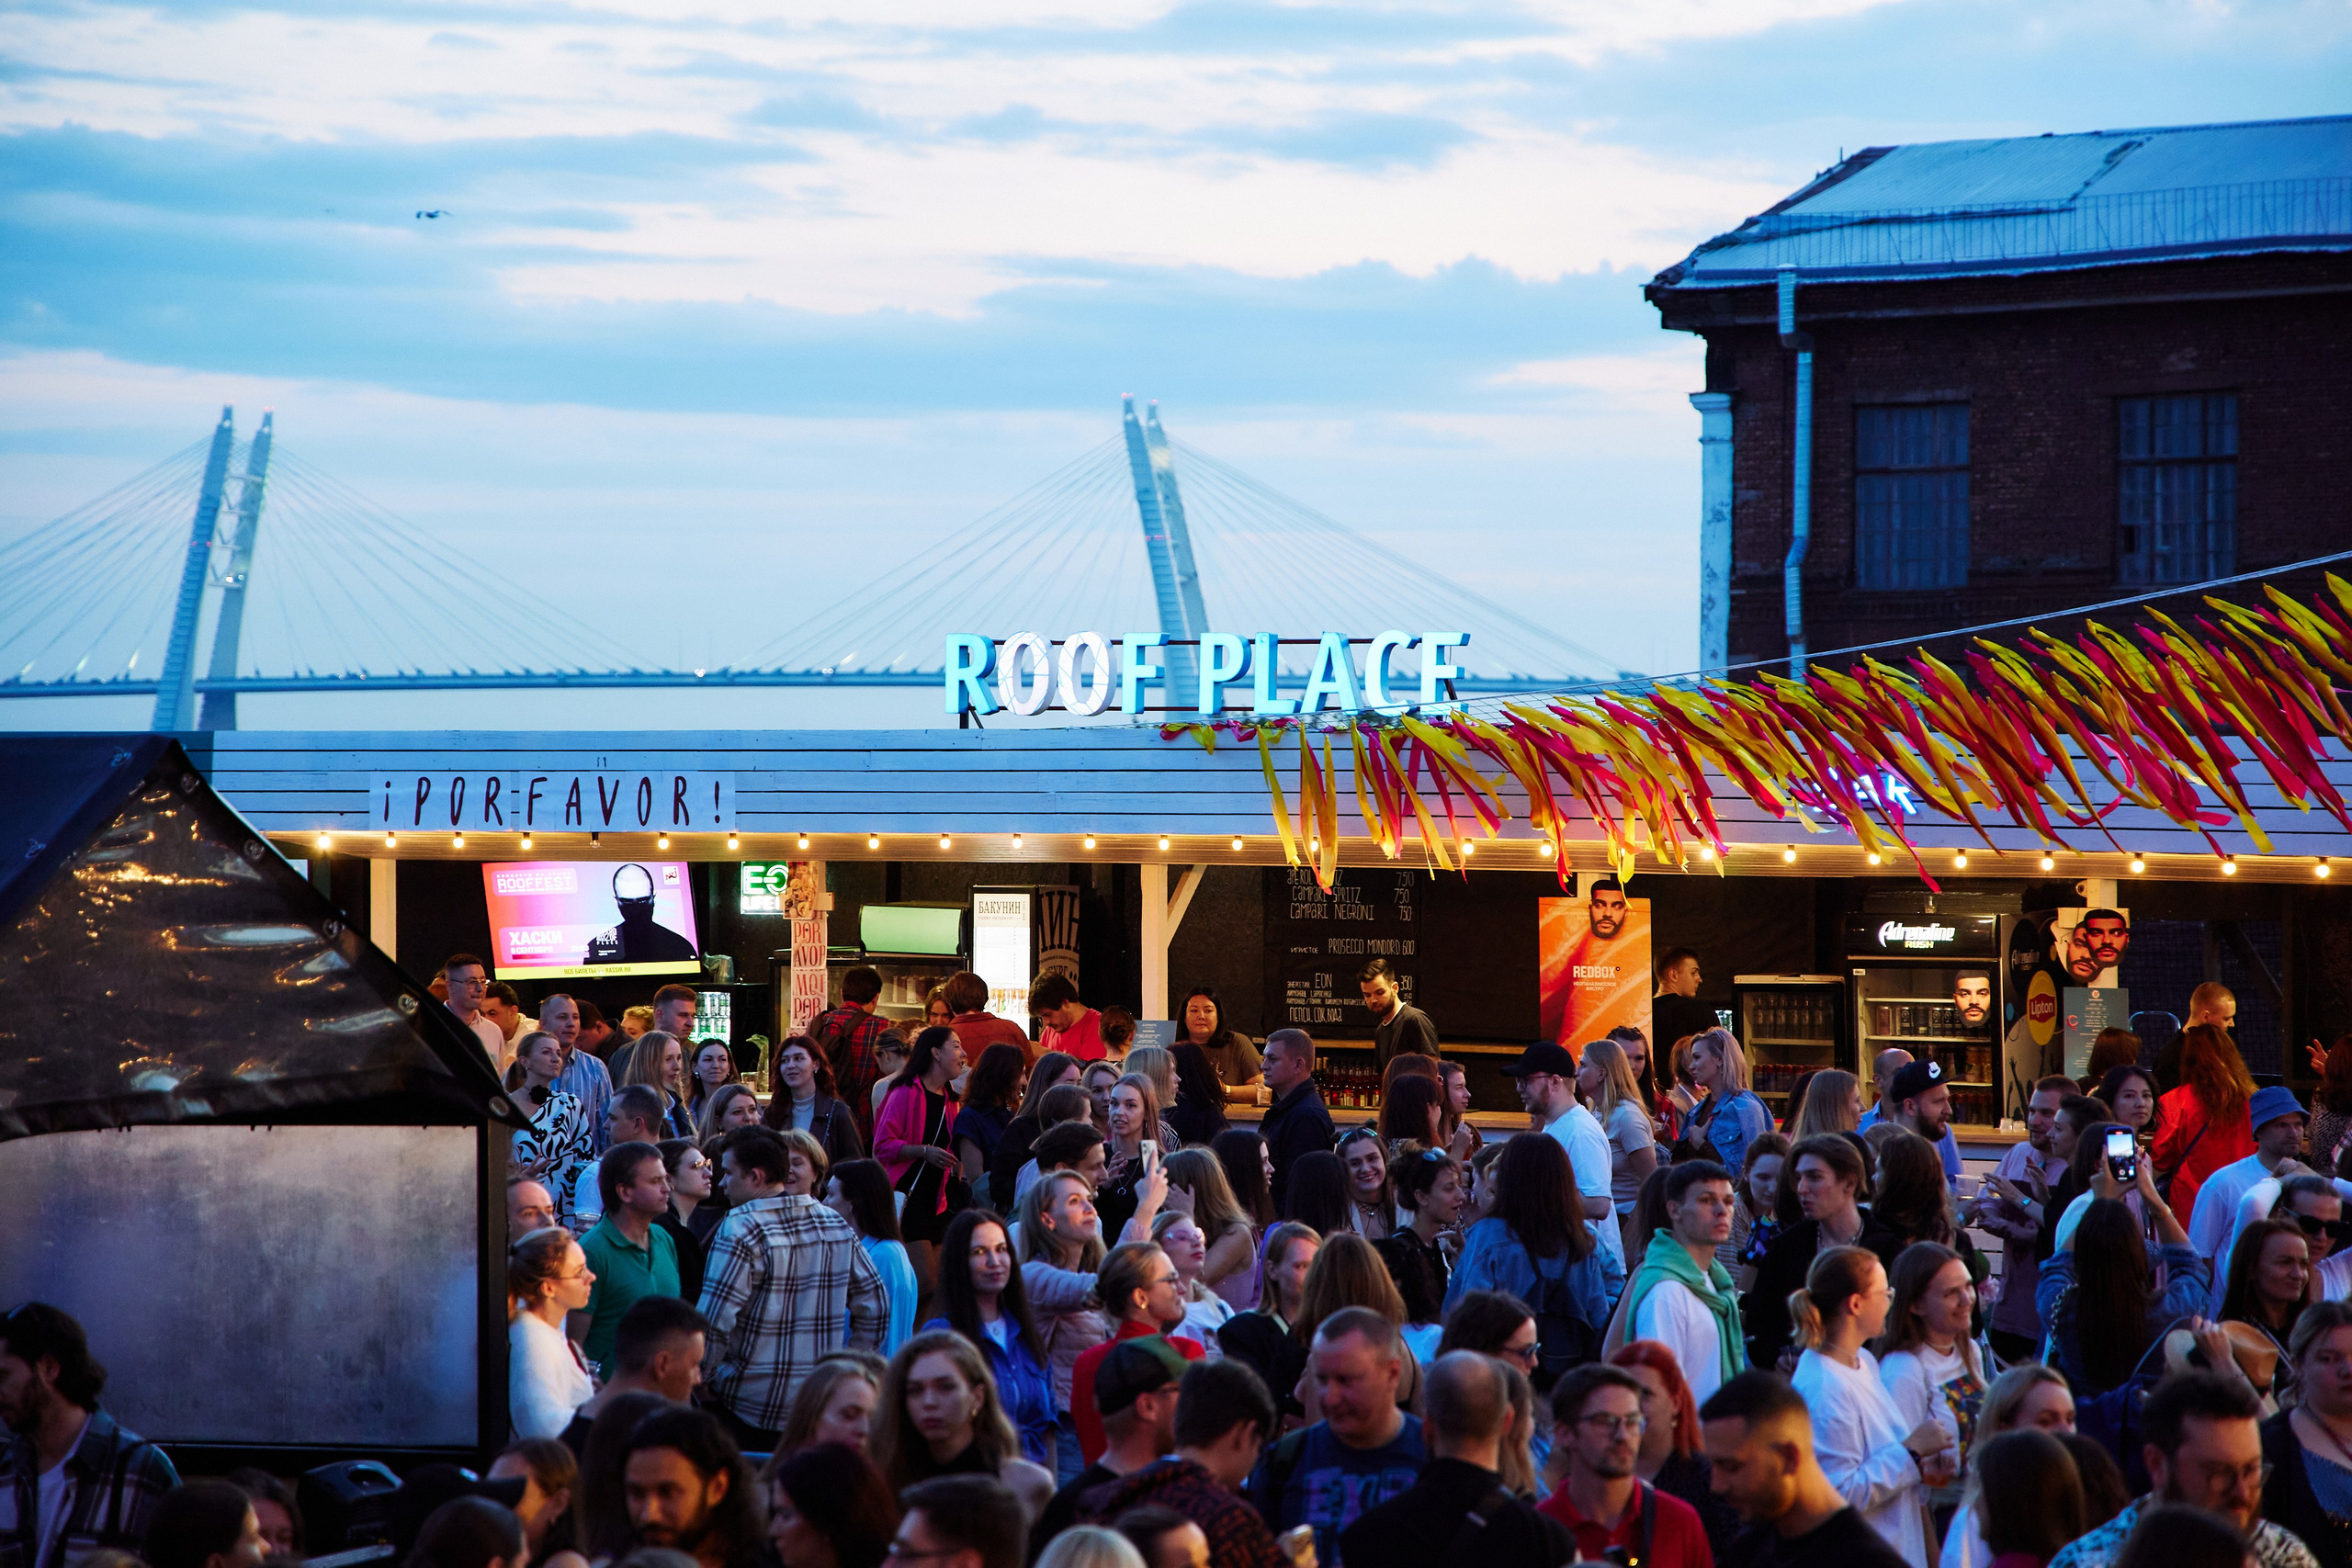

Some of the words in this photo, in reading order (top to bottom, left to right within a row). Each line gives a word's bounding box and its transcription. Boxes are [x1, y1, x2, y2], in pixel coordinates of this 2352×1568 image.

[945, 631, 1170, 716] ROOF
[1198, 630, 1470, 718] PLACE
[527, 775, 720, 826] FAVOR!
[497, 876, 572, 890] ROOFFEST
[1396, 872, 1414, 887] 750
[1333, 886, 1361, 904] SPRITZ
[1394, 888, 1409, 904] 750
[978, 900, 1021, 914] БАКУНИН
[1334, 904, 1374, 920] NEGRONI
[1398, 906, 1412, 921] 750
[509, 930, 563, 945] ХАСКИ
[794, 921, 821, 943] POR
[1878, 920, 1956, 948] Adrenaline
[515, 946, 553, 954] СЕНТЯБРЯ
[1328, 938, 1364, 955] PROSECCO
[1402, 940, 1415, 956] 600
[1904, 941, 1934, 949] RUSH
[1573, 965, 1616, 978] REDBOX
[1315, 973, 1332, 988] EON
[1400, 976, 1413, 991] 350
[794, 997, 821, 1019] POR
[2030, 1001, 2053, 1018] Lipton
